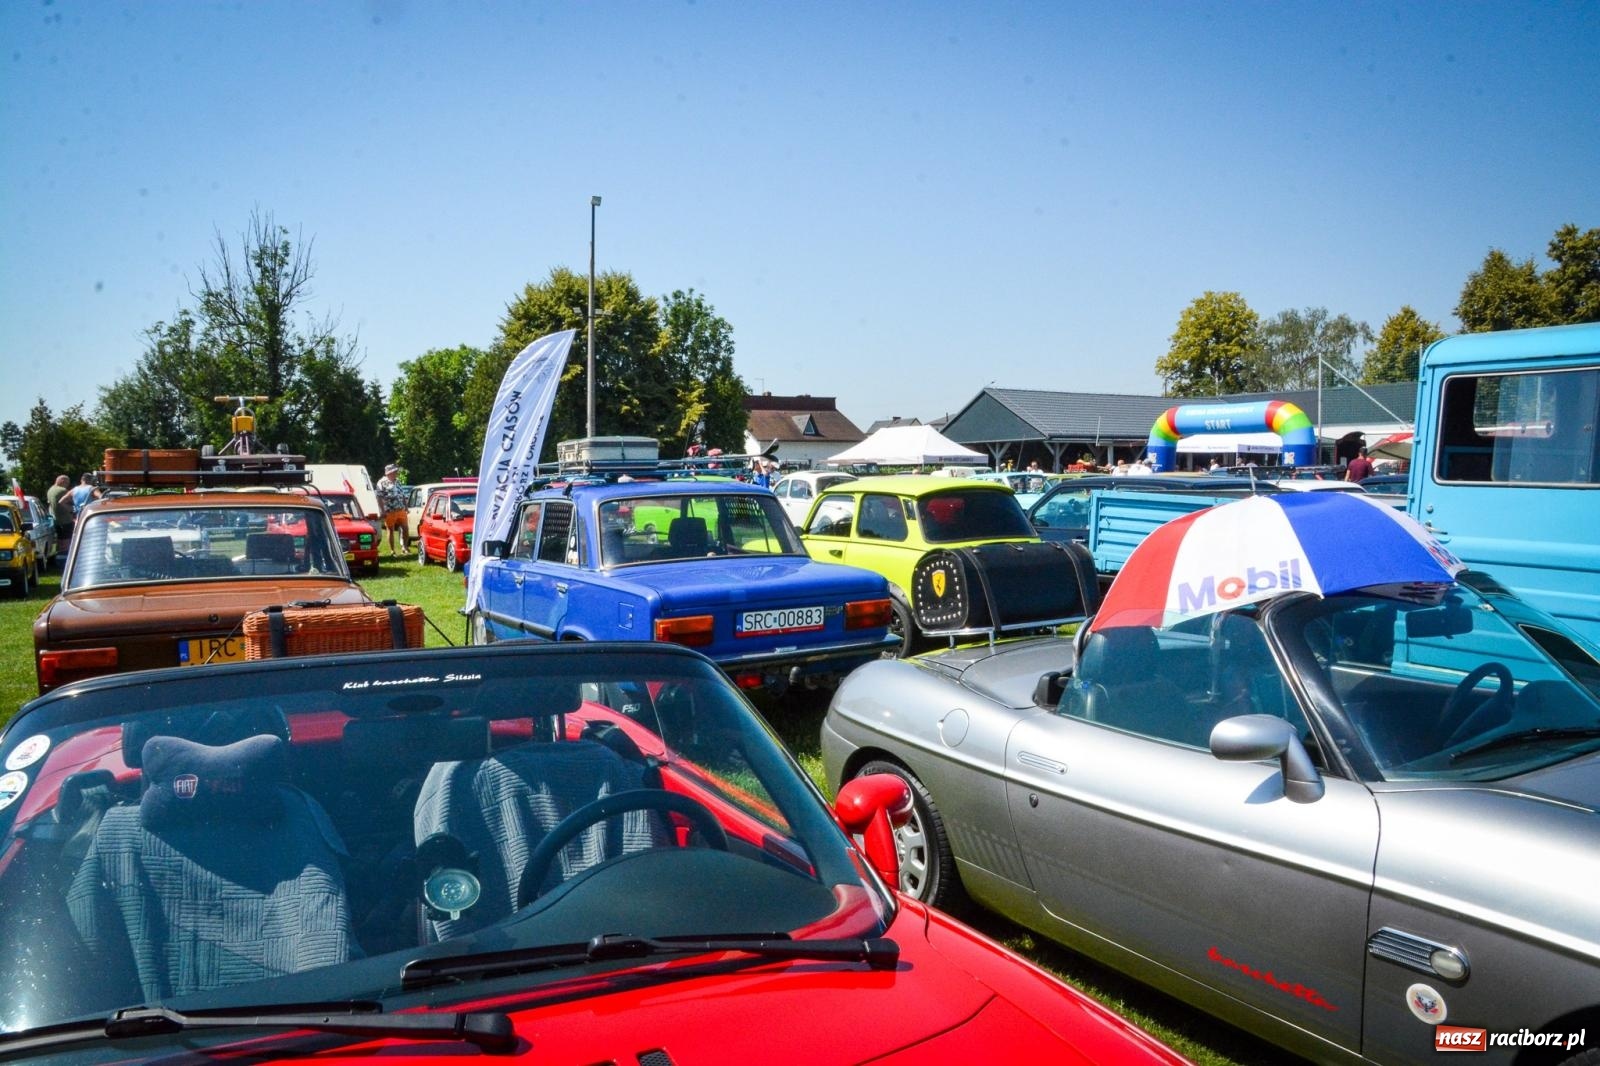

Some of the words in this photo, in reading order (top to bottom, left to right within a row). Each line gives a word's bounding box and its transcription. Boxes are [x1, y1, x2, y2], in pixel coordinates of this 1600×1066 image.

[501, 391, 521, 452] CZASÓW
[1204, 418, 1231, 430] START
[1178, 558, 1302, 615] Mobil
[744, 612, 773, 631] SRC
[778, 608, 823, 627] 00883
[342, 681, 369, 690] Klub
[443, 673, 482, 683] Silesia
[176, 779, 196, 793] FIAT
